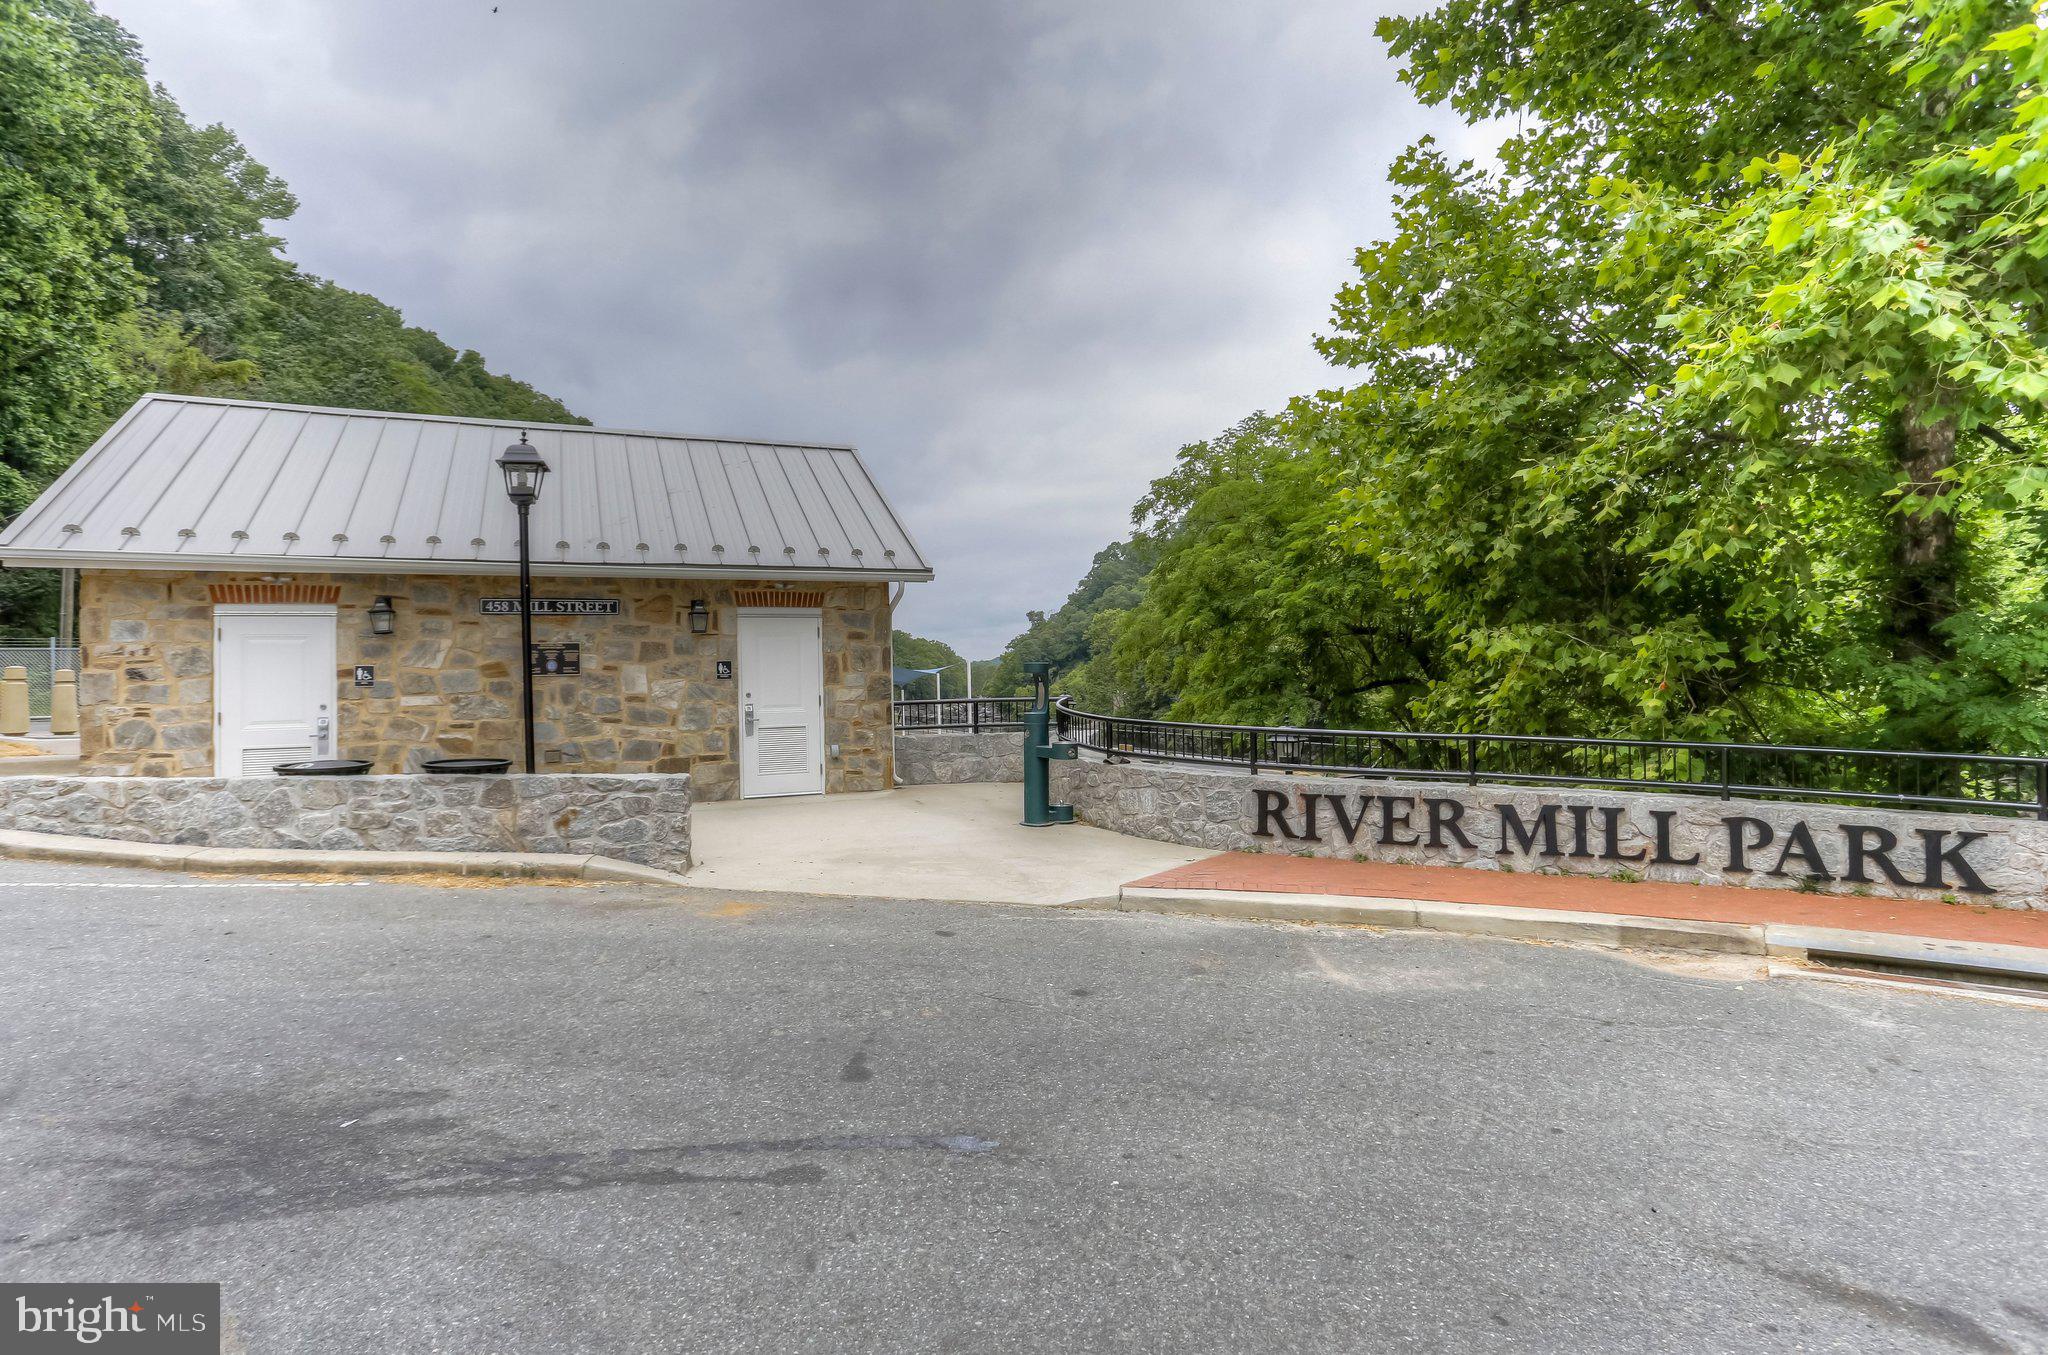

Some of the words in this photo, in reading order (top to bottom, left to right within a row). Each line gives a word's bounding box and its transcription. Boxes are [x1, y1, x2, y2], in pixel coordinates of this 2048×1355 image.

[485, 601, 509, 612] 458
[556, 601, 614, 613] STREET
[1252, 788, 1478, 849] RIVER
[1494, 803, 1700, 866] MILL
[1722, 816, 1997, 895] PARK
